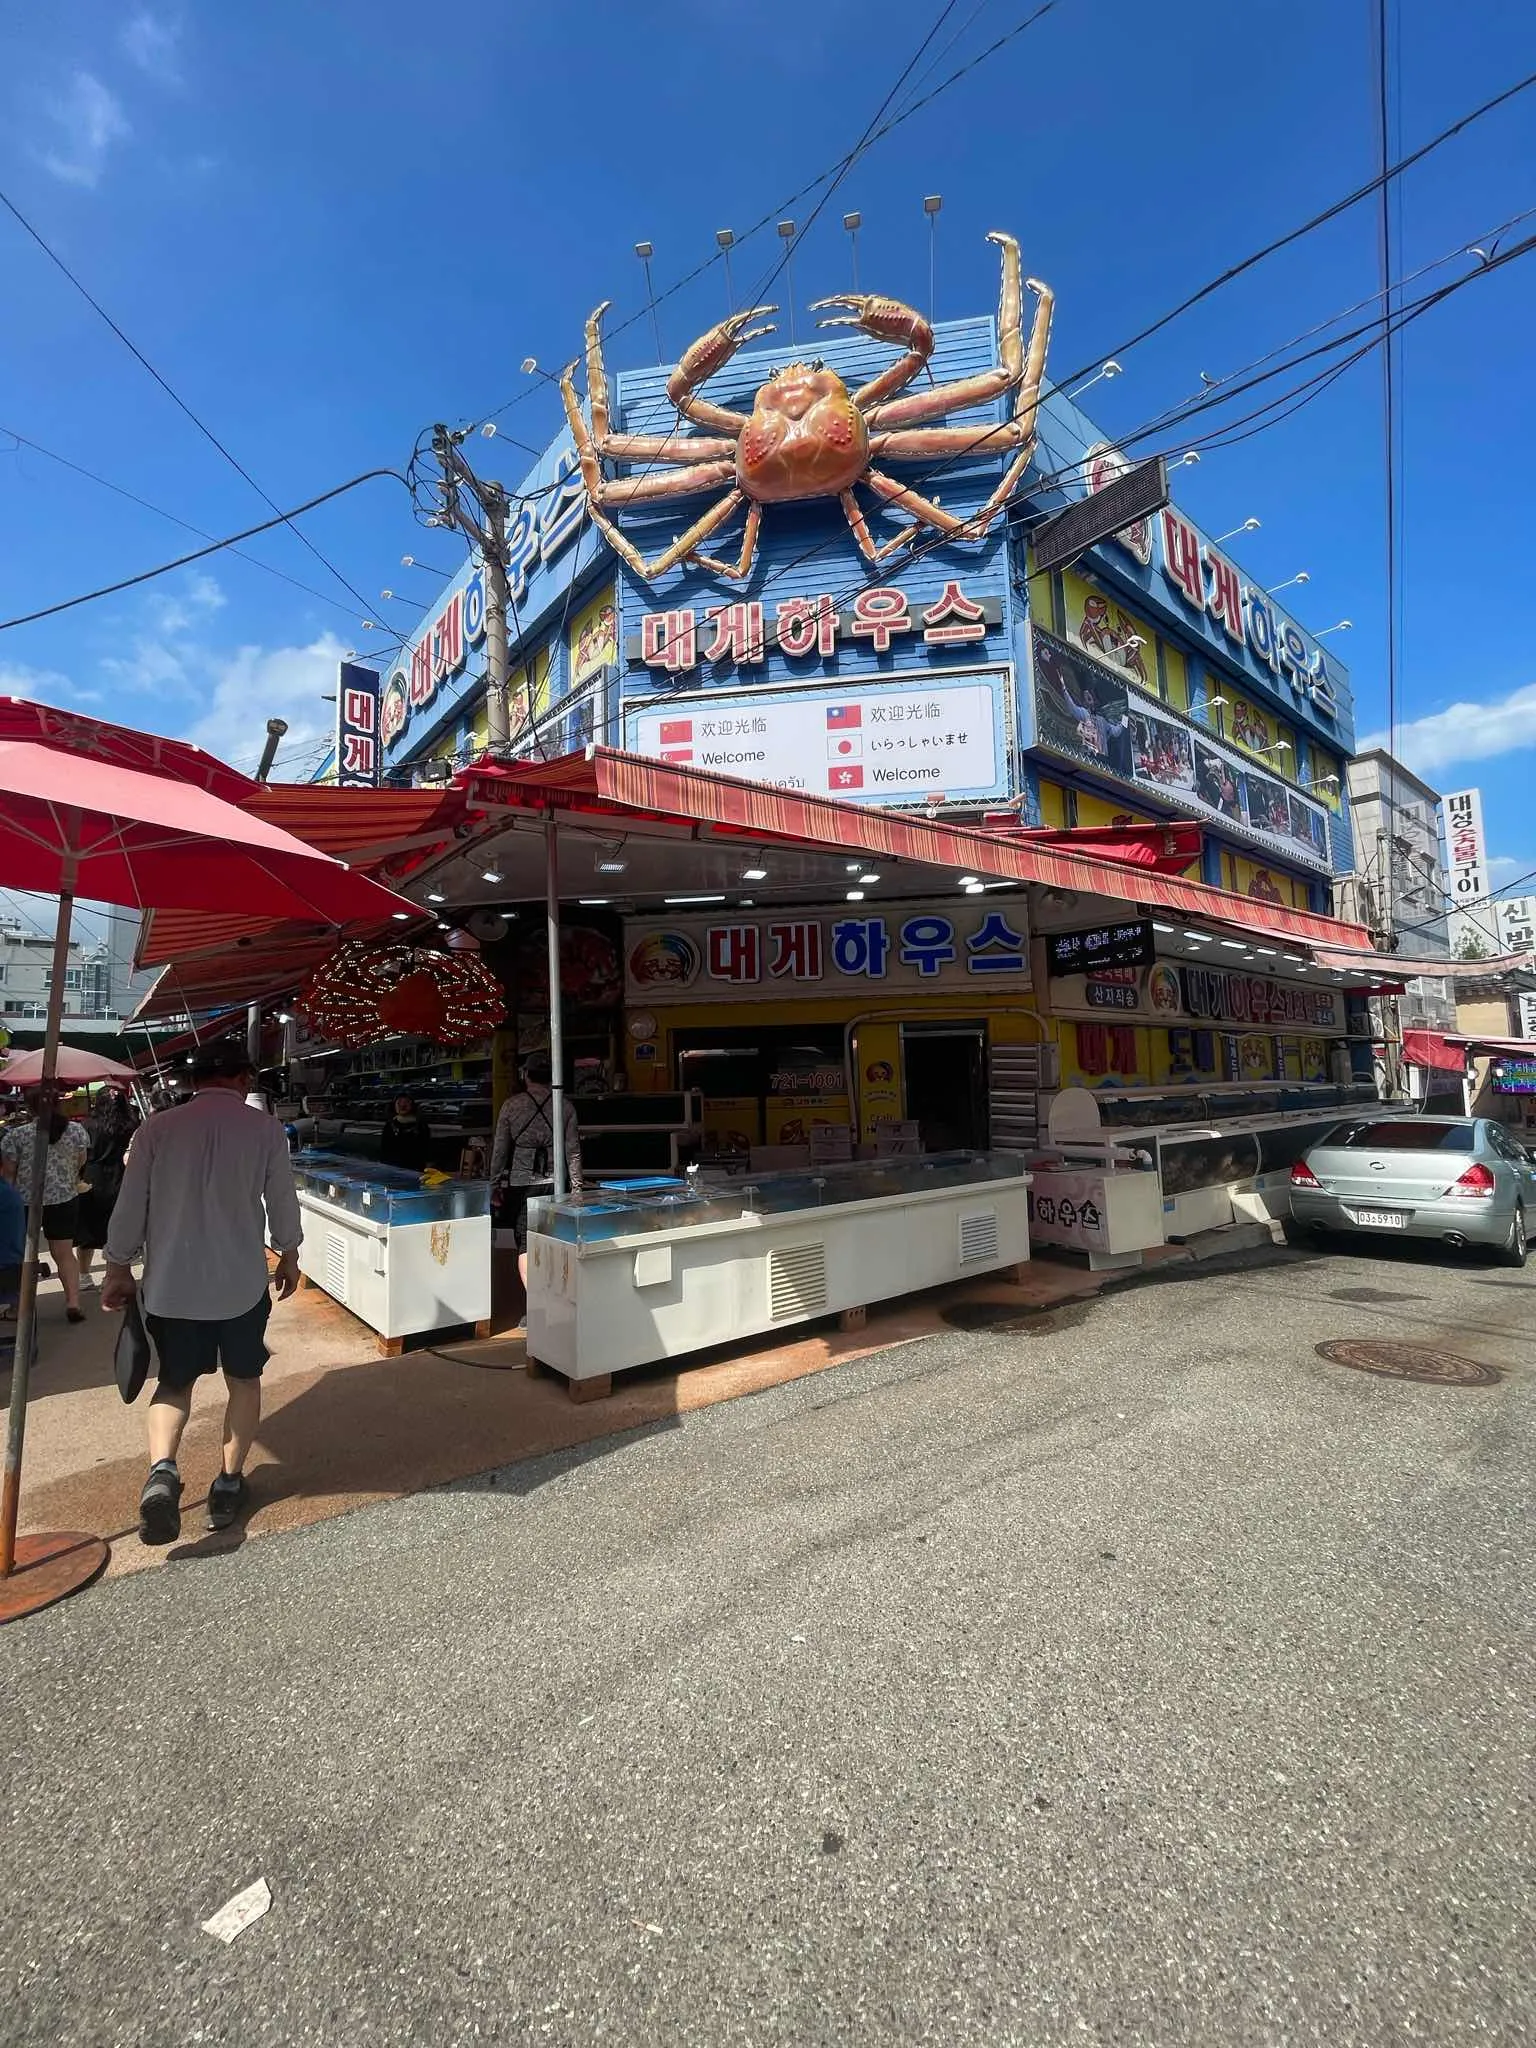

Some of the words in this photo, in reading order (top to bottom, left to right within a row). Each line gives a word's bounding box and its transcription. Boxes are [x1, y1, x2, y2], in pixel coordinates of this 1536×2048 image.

[642, 581, 986, 671] 대게하우스
[1160, 509, 1338, 719] 대게하우스
[871, 703, 941, 723] 欢迎光临
[343, 688, 375, 786] 대게
[701, 717, 768, 737] 欢迎光临
[871, 732, 968, 751] いらっしゃいませ
[702, 750, 765, 765] Welcome
[873, 768, 941, 782] Welcome
[707, 911, 1027, 984] 대게하우스
[1094, 984, 1135, 1008] 산지직송
[1027, 1191, 1101, 1231] 하우스
